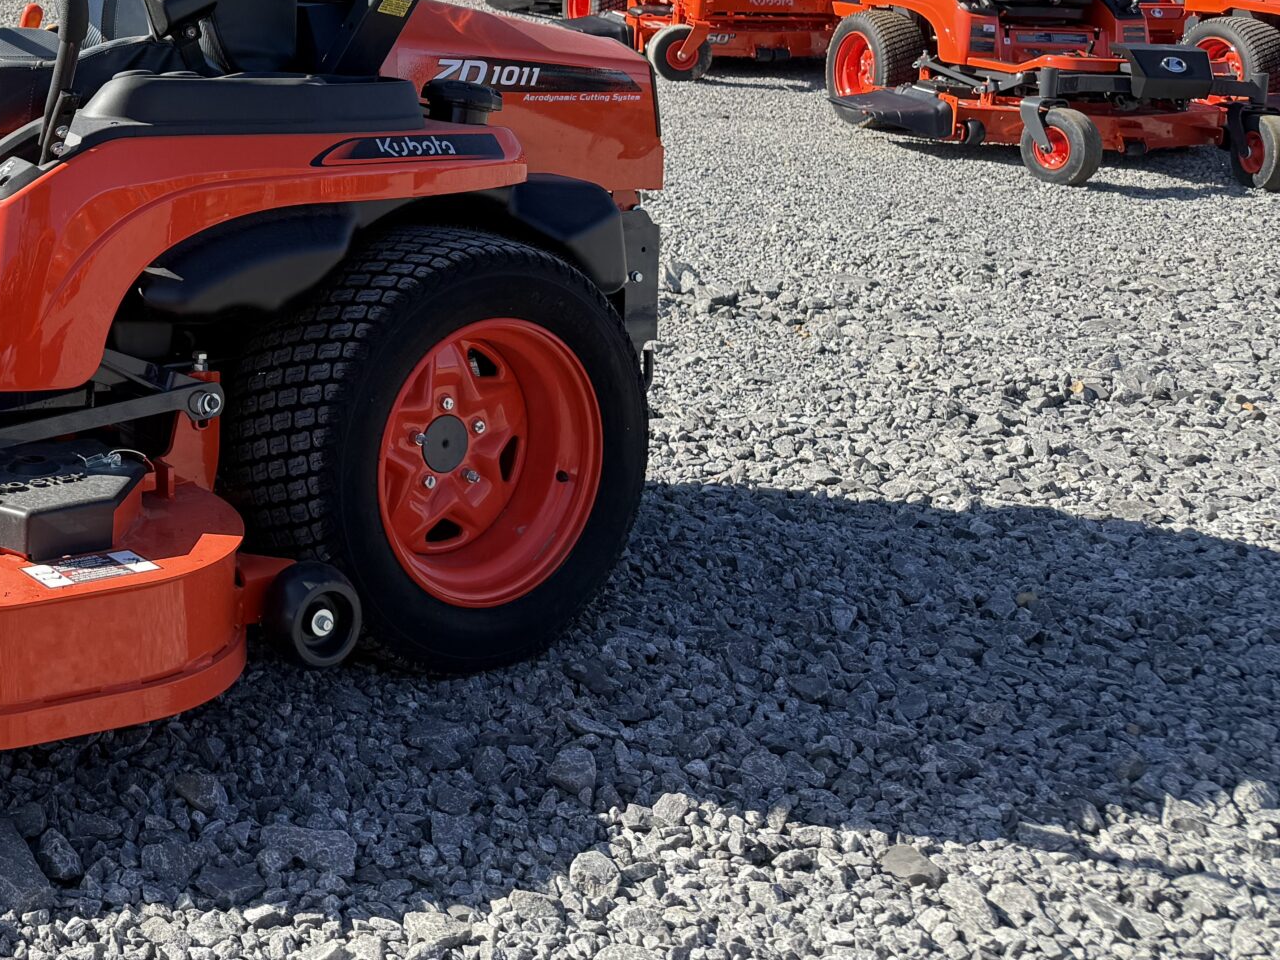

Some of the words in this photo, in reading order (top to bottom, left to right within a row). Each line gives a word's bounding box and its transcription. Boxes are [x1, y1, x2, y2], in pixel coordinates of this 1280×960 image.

[523, 93, 577, 102] Aerodynamic
[579, 93, 610, 102] Cutting
[611, 93, 641, 102] System
[375, 135, 456, 157] Kubota
